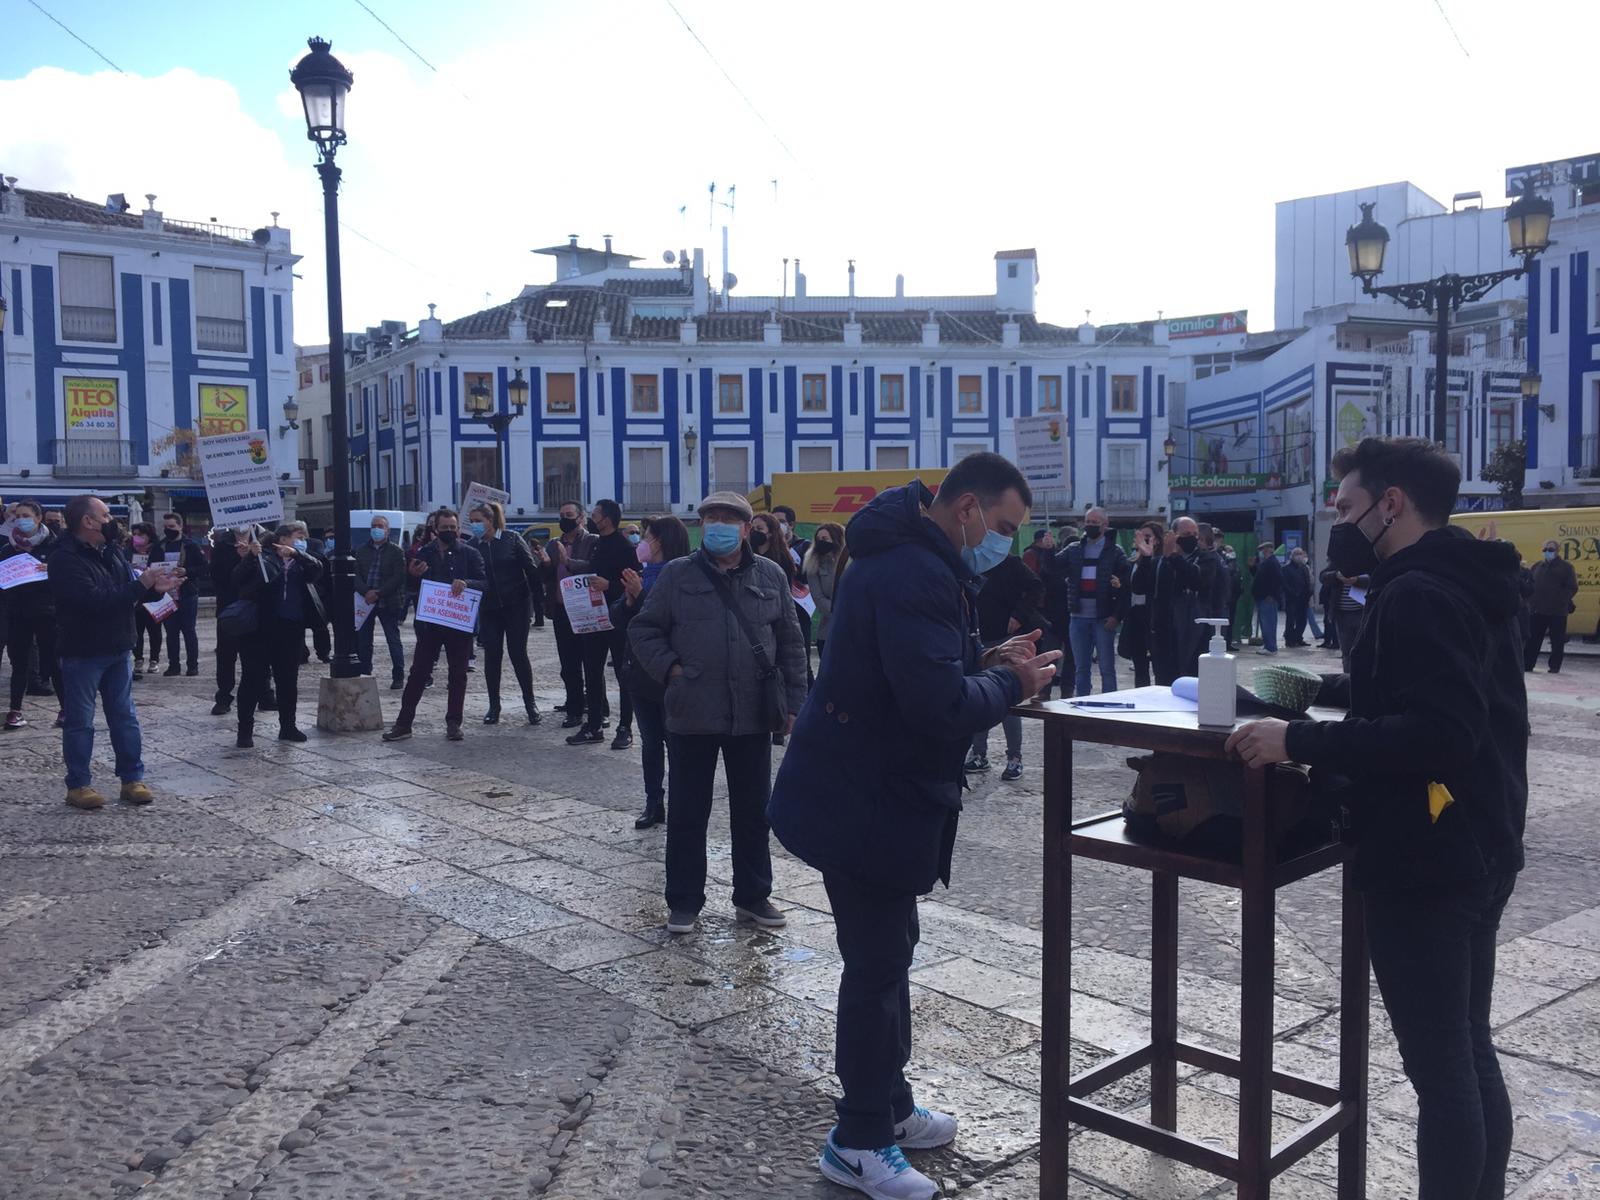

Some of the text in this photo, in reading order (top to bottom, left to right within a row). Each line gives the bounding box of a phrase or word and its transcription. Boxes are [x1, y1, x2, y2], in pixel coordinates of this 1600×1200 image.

[68, 389, 114, 406] TEO
[71, 407, 114, 418] Alquila
[1168, 475, 1257, 488] ash Ecofamilia
